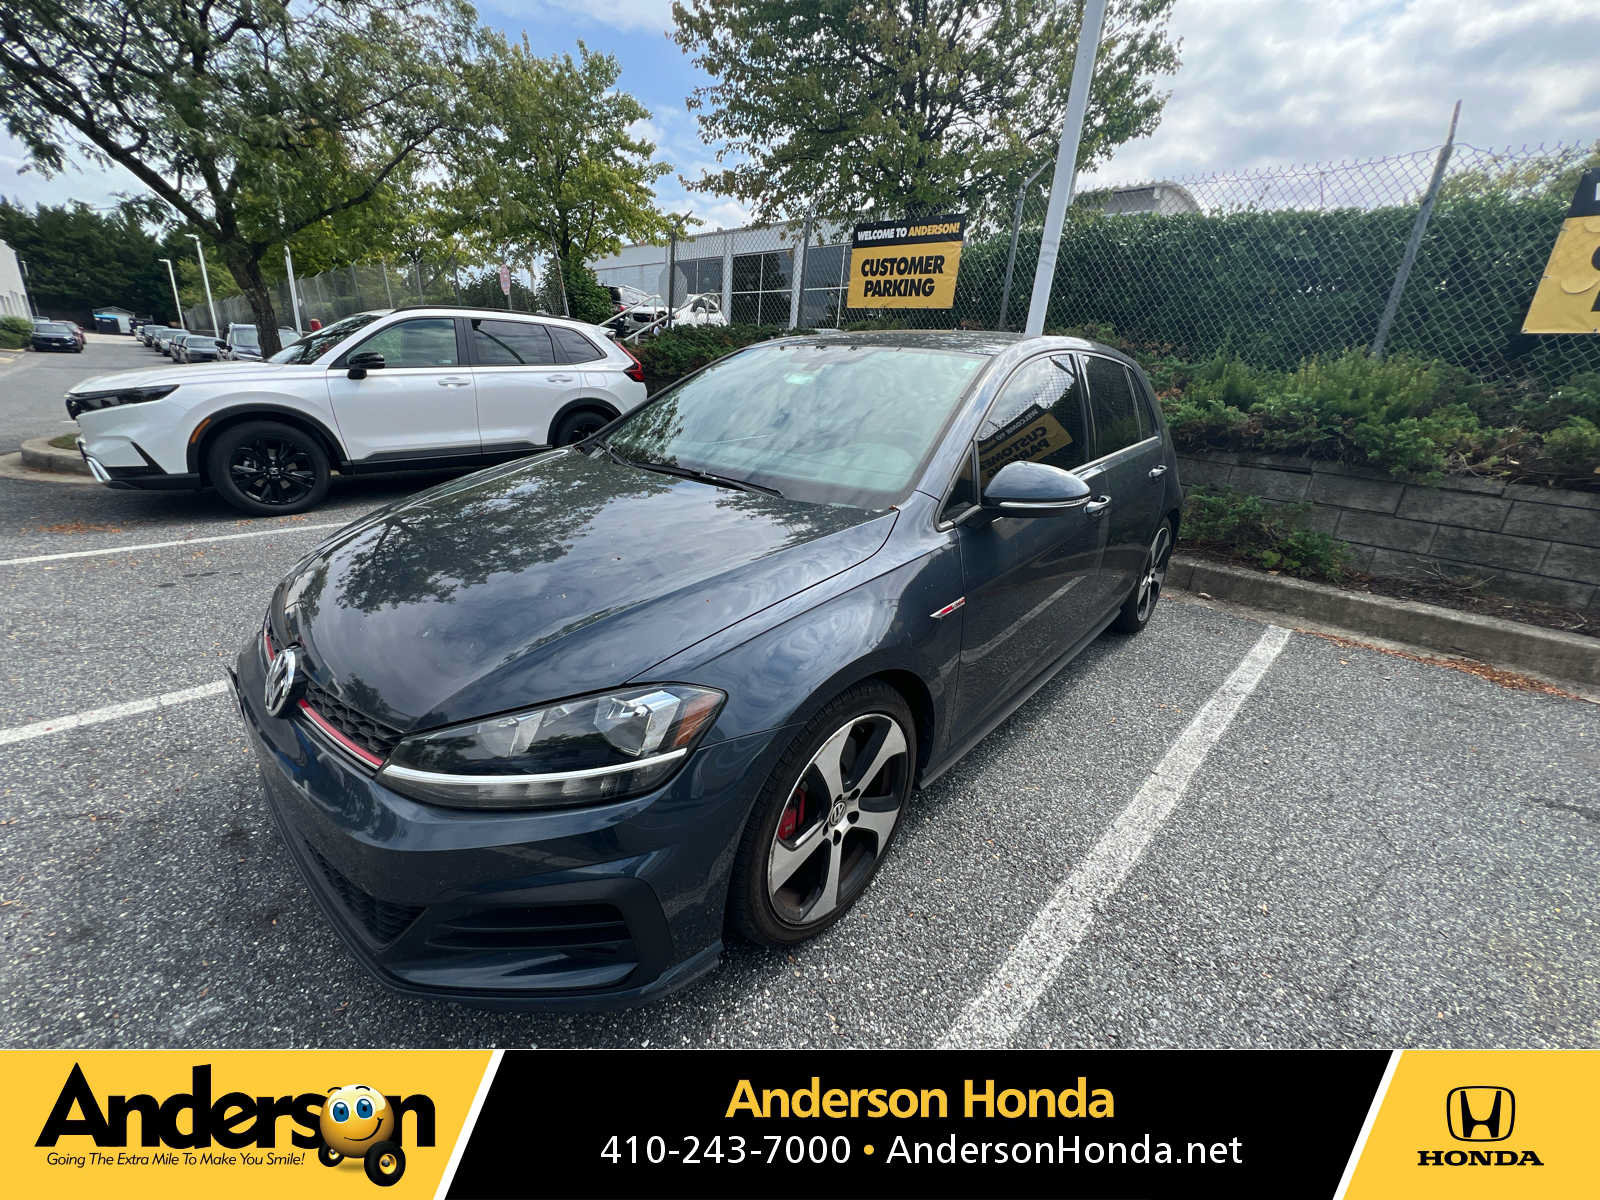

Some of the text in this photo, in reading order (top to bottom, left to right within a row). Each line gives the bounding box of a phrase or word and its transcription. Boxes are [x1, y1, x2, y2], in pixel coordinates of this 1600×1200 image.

[857, 222, 961, 241] WELCOME TO ANDERSON!
[861, 255, 945, 277] CUSTOMER
[863, 278, 935, 297] PARKING
